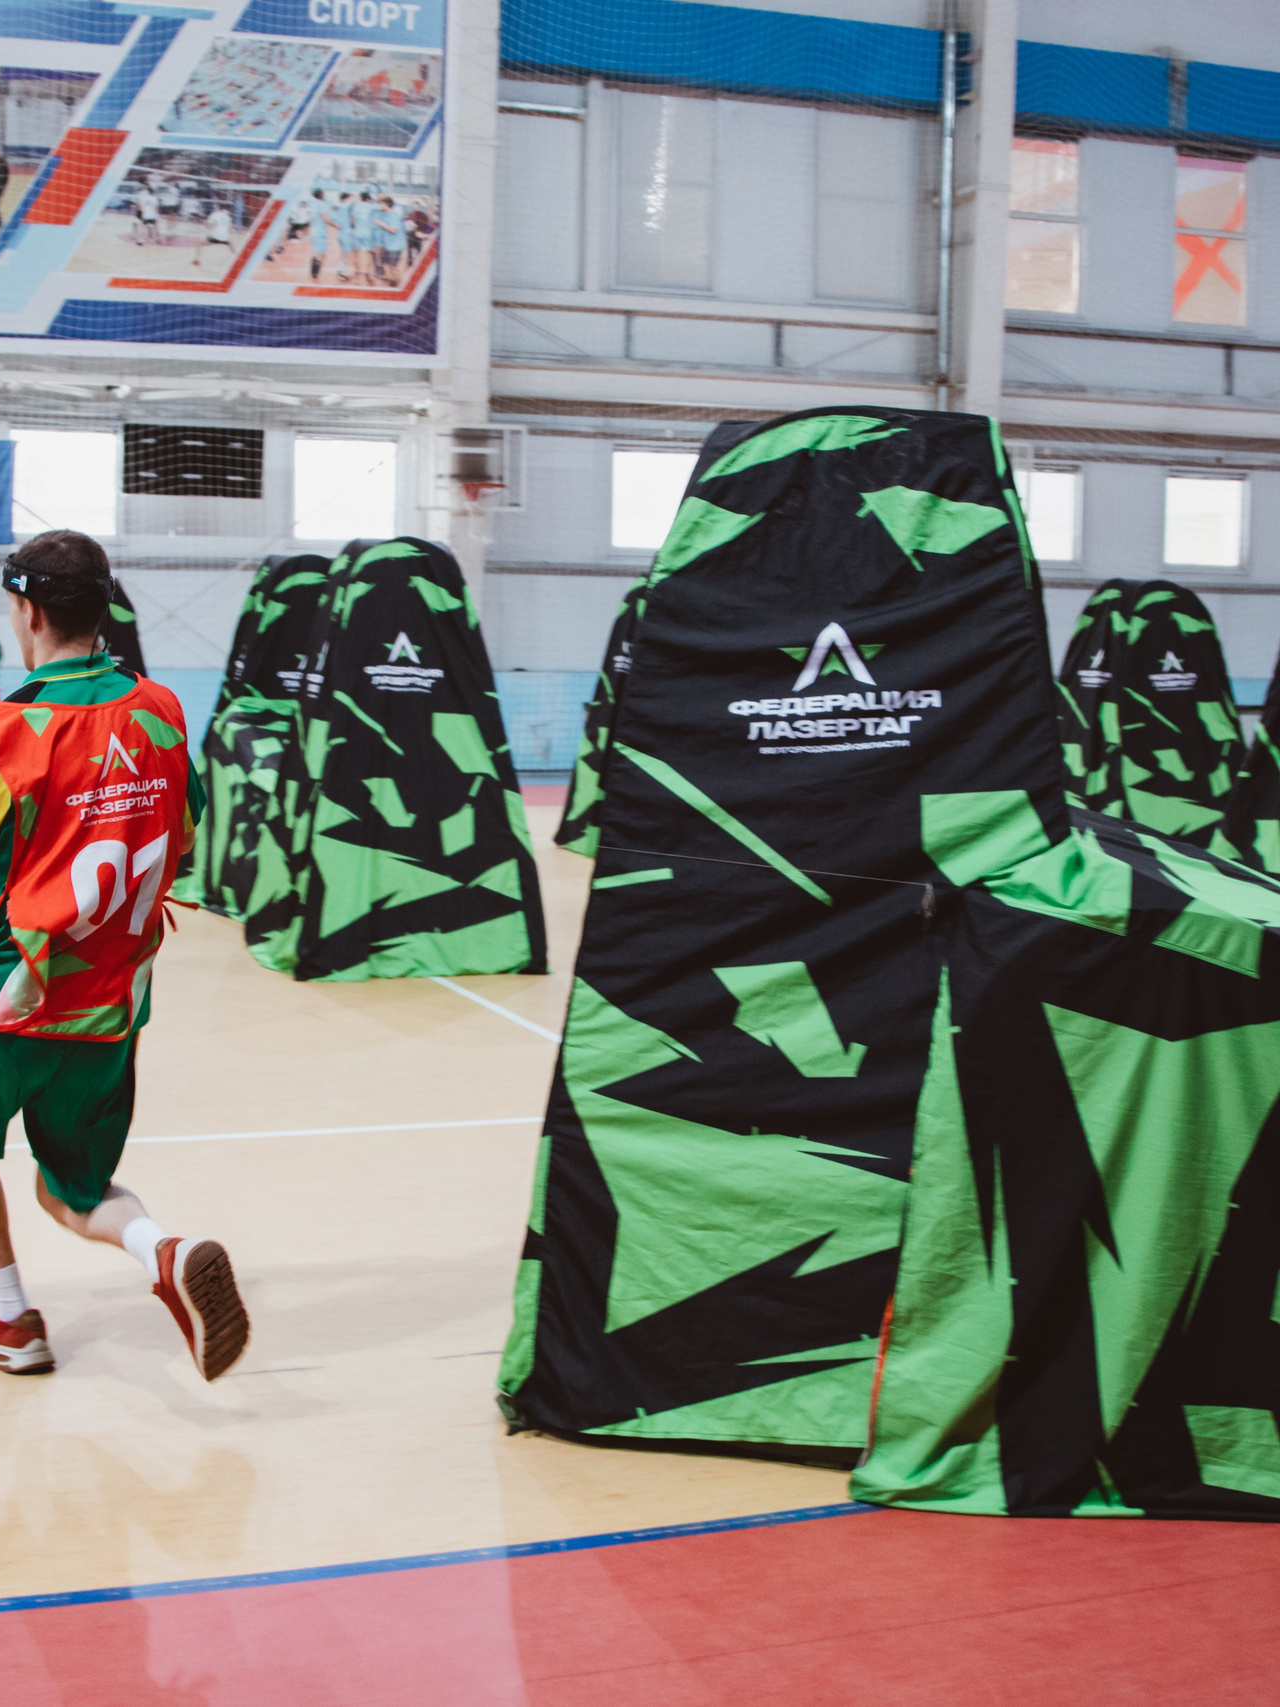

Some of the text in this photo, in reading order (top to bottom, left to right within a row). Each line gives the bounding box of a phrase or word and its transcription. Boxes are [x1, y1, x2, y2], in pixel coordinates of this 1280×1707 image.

[308, 0, 421, 31] СПОРТ
[728, 690, 942, 717] ФЕДЕРАЦИЯ
[747, 715, 922, 741] ЛАЗЕРТАГ
[65, 778, 168, 806] ФЕДЕРАЦИЯ
[80, 794, 161, 820] ЛАЗЕРТАГ
[65, 830, 169, 942] 01
